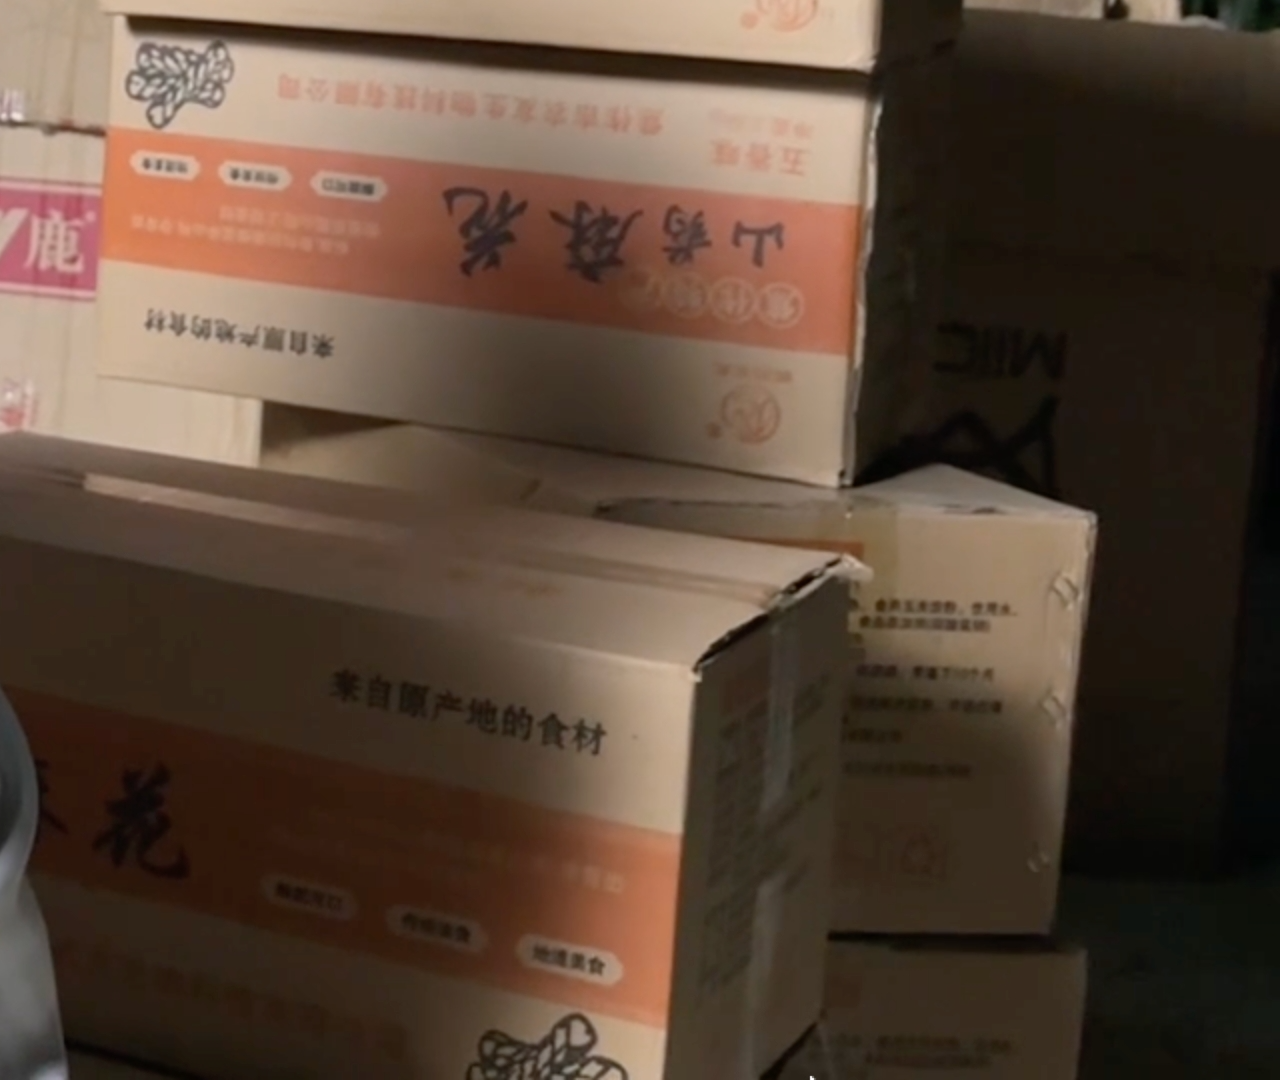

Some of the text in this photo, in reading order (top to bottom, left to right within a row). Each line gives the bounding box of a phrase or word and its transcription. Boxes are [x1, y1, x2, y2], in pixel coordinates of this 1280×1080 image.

[442, 184, 786, 281] 山药麻花
[144, 307, 336, 360] 来自原产地的食材
[328, 666, 607, 758] 来自原产地的食材
